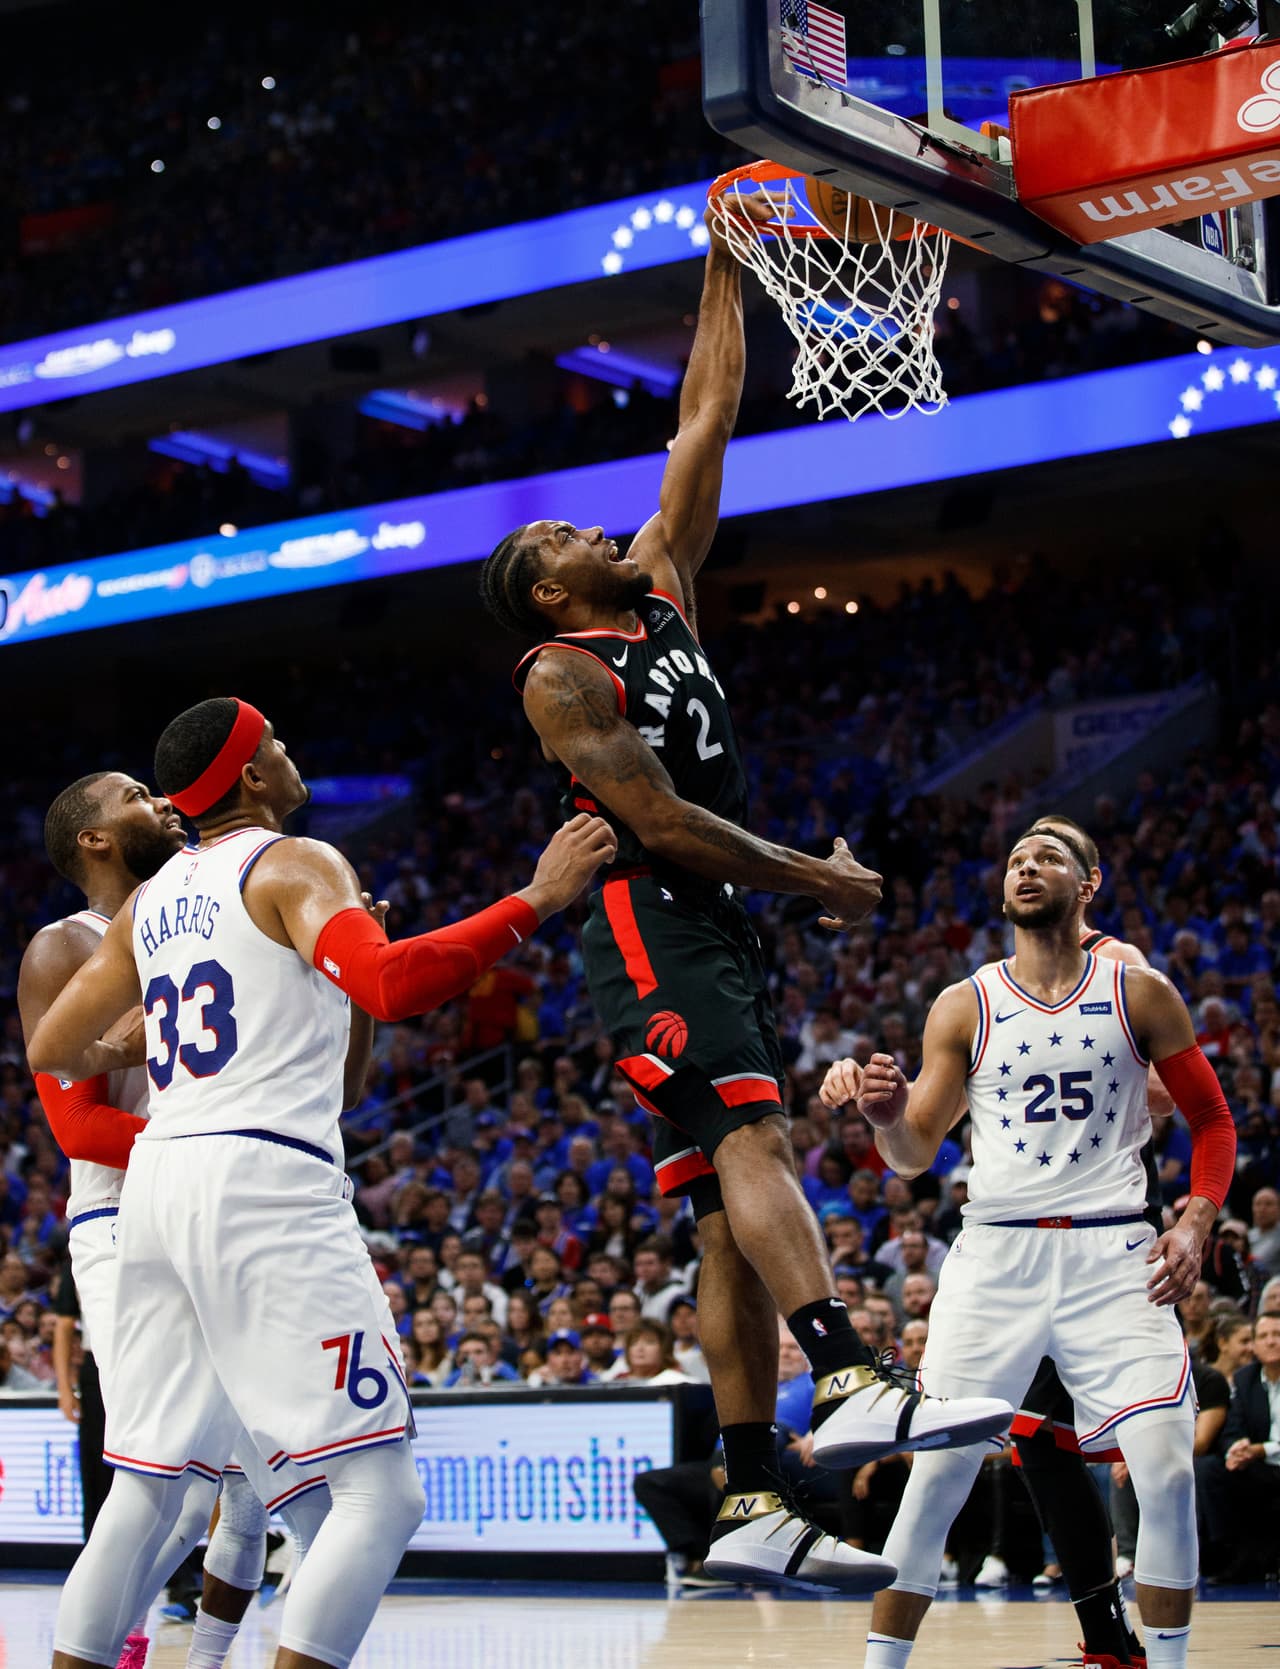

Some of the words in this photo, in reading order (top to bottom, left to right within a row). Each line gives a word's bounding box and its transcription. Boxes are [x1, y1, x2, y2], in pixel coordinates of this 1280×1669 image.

[1078, 168, 1254, 222] Farm
[1204, 224, 1220, 249] NBA
[686, 697, 724, 761] 2
[140, 894, 220, 957] HARRIS
[143, 959, 238, 1092] 33
[1082, 1004, 1109, 1013] StubHub
[1022, 1070, 1094, 1123] 25
[321, 1330, 388, 1409] 76
[827, 1372, 852, 1397] N
[416, 1437, 654, 1539] ampionship
[732, 1497, 758, 1517] N
